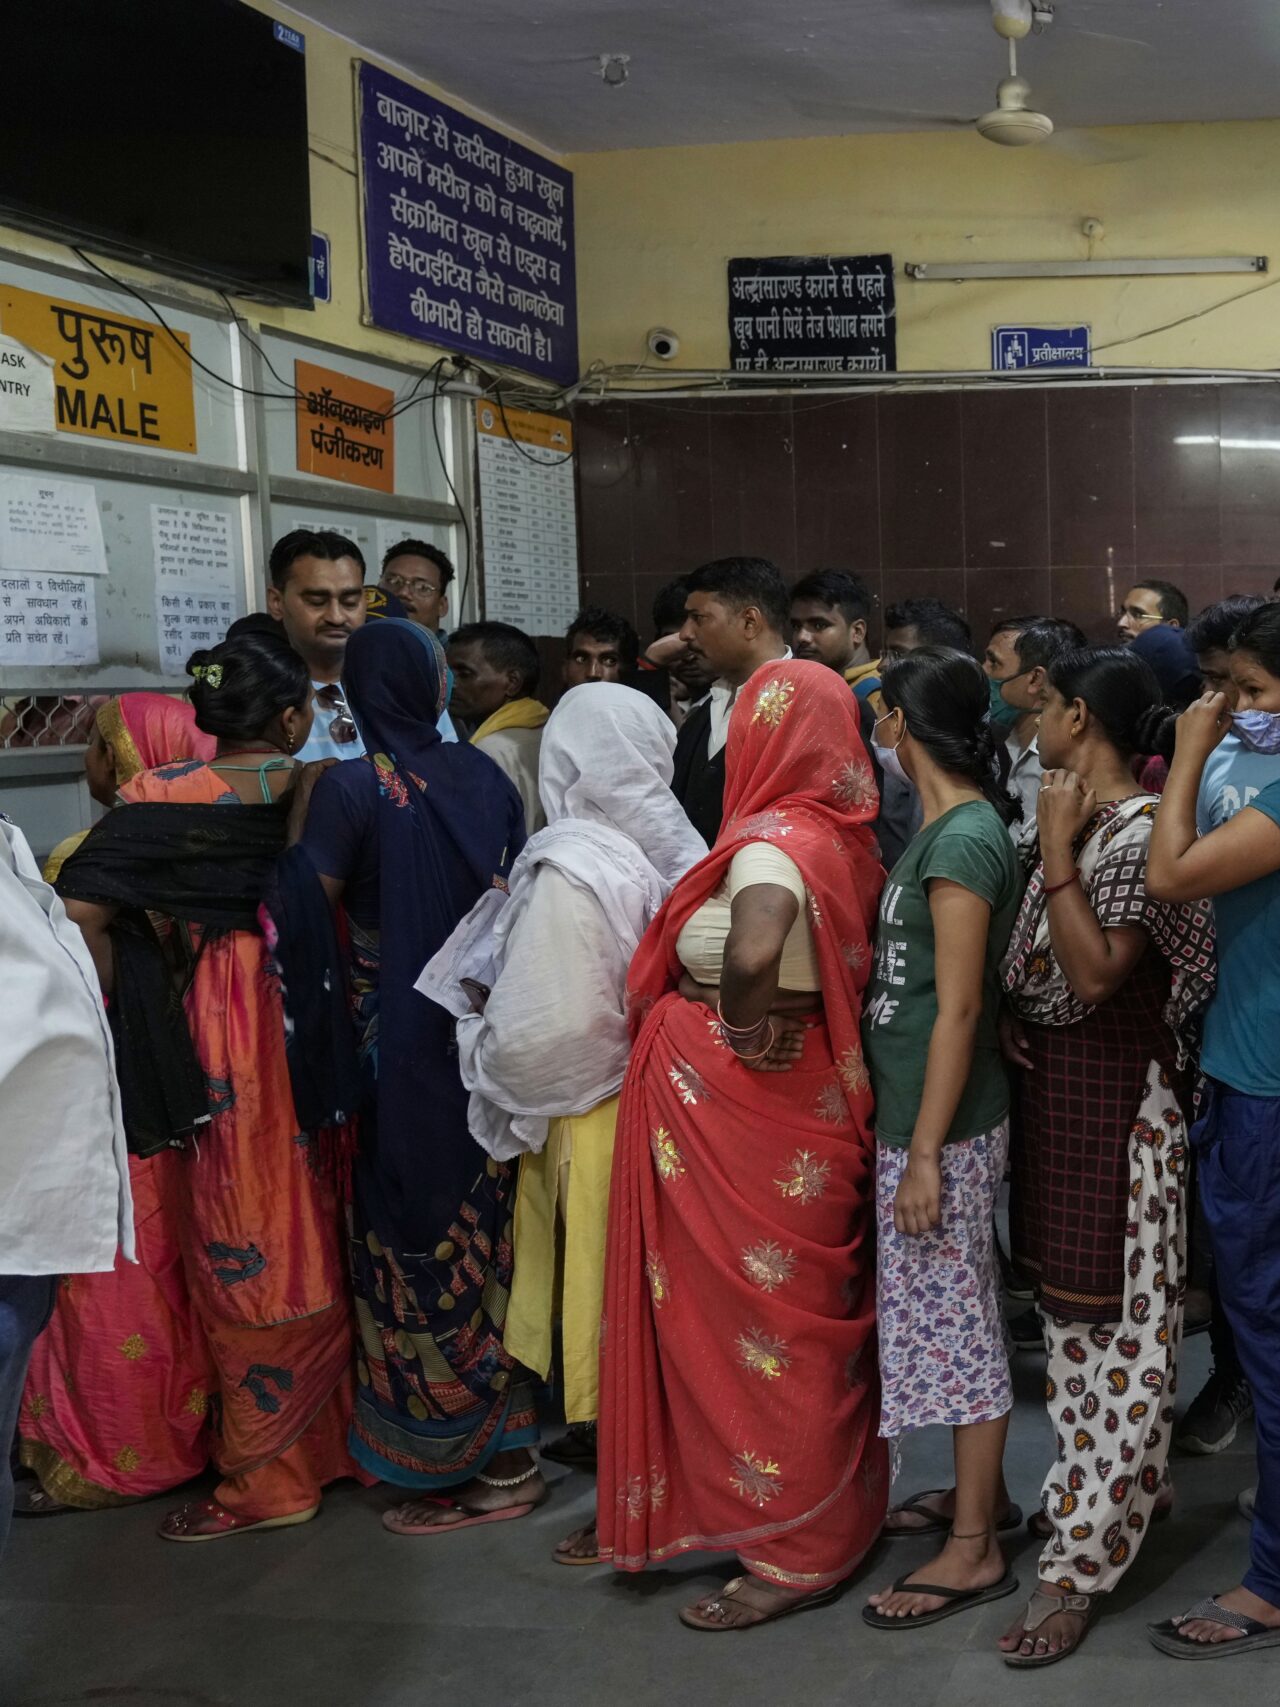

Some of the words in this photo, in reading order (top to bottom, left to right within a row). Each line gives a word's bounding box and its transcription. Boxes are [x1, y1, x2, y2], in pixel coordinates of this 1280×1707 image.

[376, 92, 430, 142] बाज़ार
[432, 114, 449, 151] से
[452, 130, 502, 177] खरीदा
[503, 156, 534, 193] हुआ
[535, 172, 564, 213] खून
[377, 142, 423, 184] अपने
[426, 162, 471, 213] मरीज़
[473, 183, 496, 217] को
[499, 197, 514, 225] न
[389, 187, 458, 244] संक्रमित
[461, 222, 494, 265] खून
[496, 232, 511, 265] से
[549, 259, 561, 285] व
[475, 265, 505, 305] जैसे
[507, 284, 565, 327] जानलेवा
[805, 267, 838, 299] कराने
[842, 267, 854, 298] से
[857, 265, 886, 302] पहले
[409, 287, 463, 334] बीमारी
[465, 306, 483, 341] हो
[486, 318, 533, 357] सकती
[734, 316, 753, 349] खूब
[756, 307, 780, 339] पानी
[806, 307, 824, 338] तेज
[827, 307, 858, 338] पेशाब
[860, 305, 886, 338] लगने
[56, 386, 161, 442] MALE
[311, 423, 384, 470] पंजीकरण
[4, 611, 25, 625] अपने
[26, 597, 58, 608] सावधान
